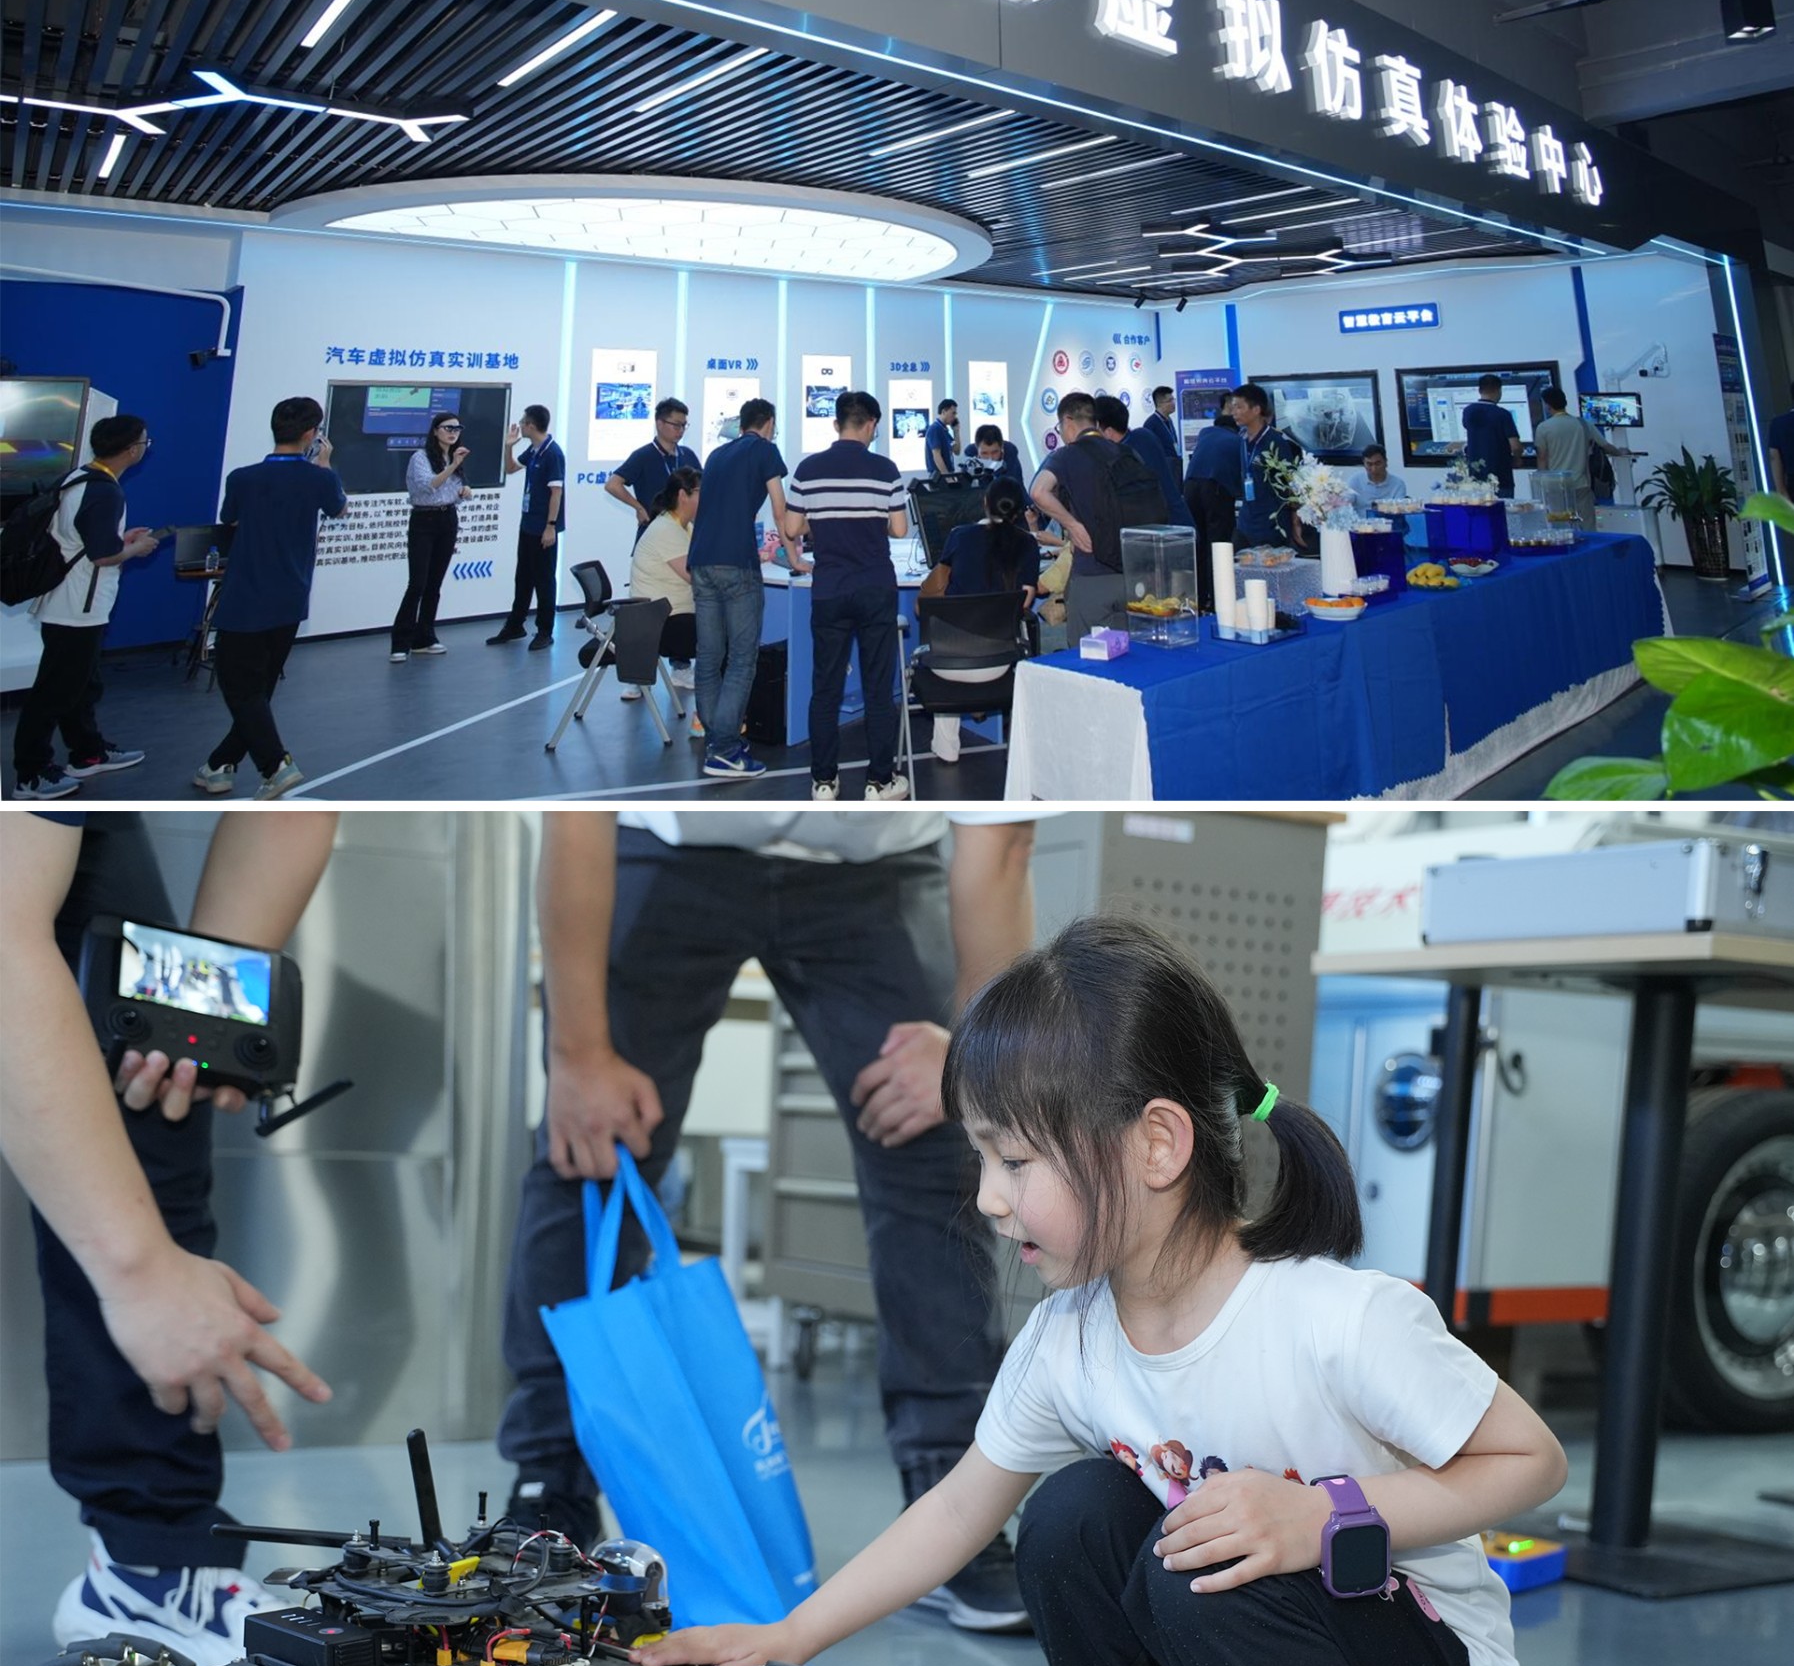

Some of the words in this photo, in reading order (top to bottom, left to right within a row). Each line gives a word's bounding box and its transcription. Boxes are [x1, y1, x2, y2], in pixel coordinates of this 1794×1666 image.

[324, 346, 520, 370] 汽车虚拟仿真实训基地
[707, 357, 742, 370] 桌面VR
[889, 361, 918, 372] 3D全息
